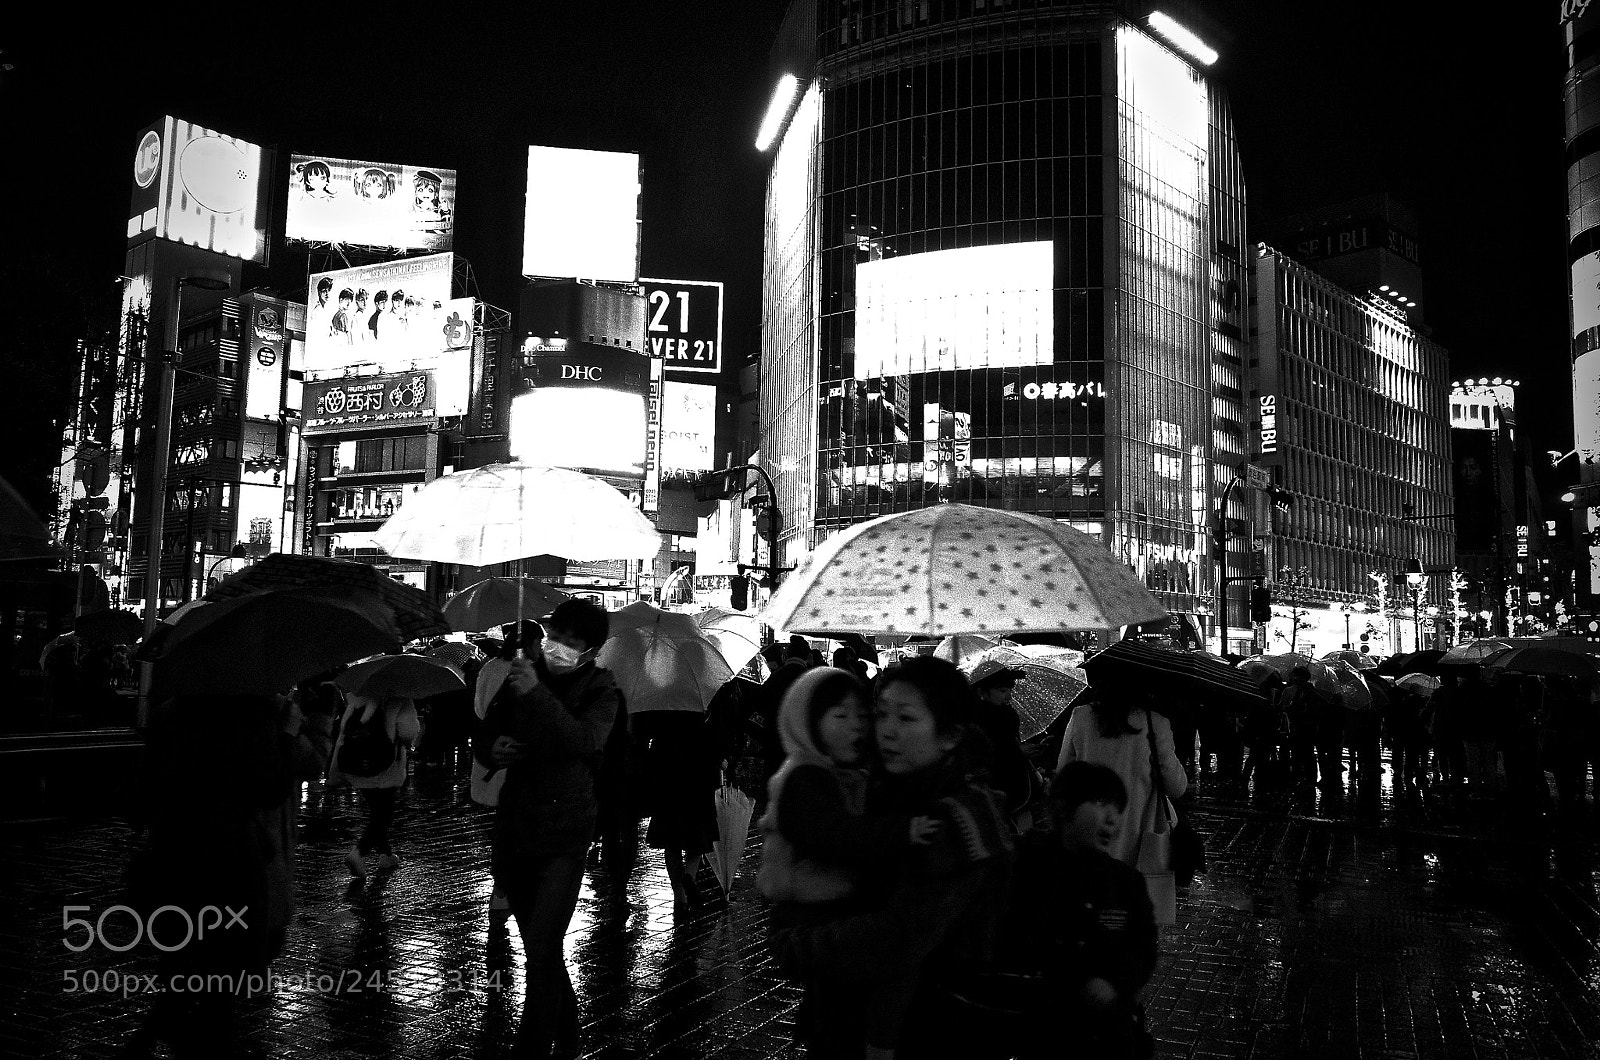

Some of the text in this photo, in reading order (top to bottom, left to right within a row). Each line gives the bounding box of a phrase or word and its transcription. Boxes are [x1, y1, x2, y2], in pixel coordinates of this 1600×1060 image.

[1297, 227, 1368, 260] SEIBU
[1388, 229, 1419, 263] SEIBU
[648, 289, 690, 334] 21
[536, 344, 566, 352] Channel
[694, 339, 714, 362] 21
[560, 364, 603, 382] DHC
[346, 391, 384, 412] 西村
[1259, 394, 1278, 455] SEIBU
[646, 430, 656, 471] neon
[1516, 525, 1529, 557] SEIBU
